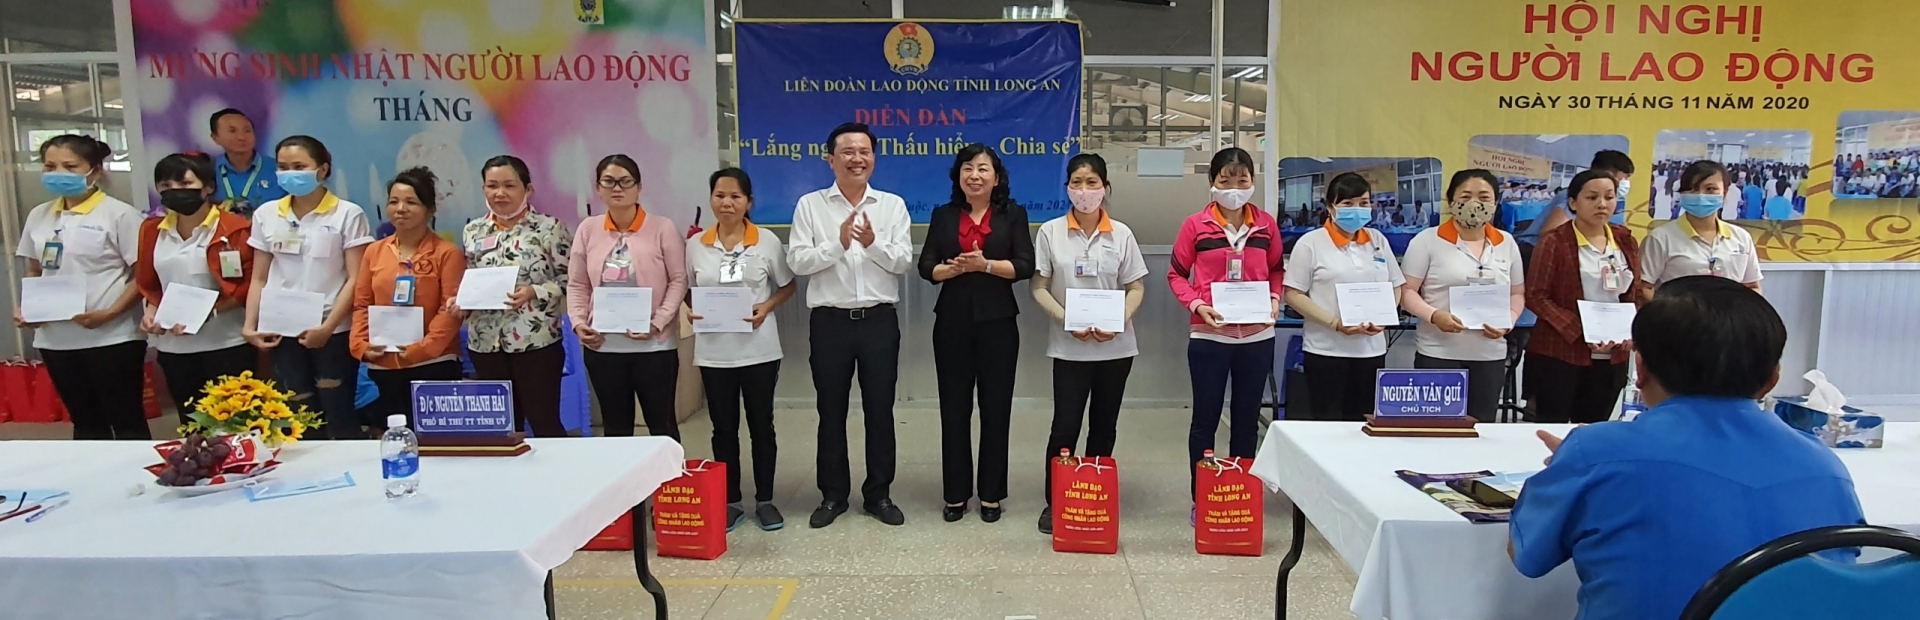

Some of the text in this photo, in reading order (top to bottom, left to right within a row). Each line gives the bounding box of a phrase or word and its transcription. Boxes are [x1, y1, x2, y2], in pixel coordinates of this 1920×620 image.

[1524, 0, 1762, 42] HỘI NGHỊ
[250, 53, 322, 79] SINH
[331, 48, 414, 87] NHẬT
[423, 45, 524, 81] NGƯỜI
[532, 54, 595, 82] LAO
[603, 51, 691, 89] ĐỘNG
[1411, 43, 1874, 89] NGƯỜI LAO ĐỘNG
[785, 76, 819, 92] LIÊN
[824, 76, 866, 92] ĐOÀN
[871, 80, 902, 92] LAO
[906, 78, 949, 94] ĐỘNG
[995, 79, 1037, 91] LONG
[1040, 79, 1061, 91] AN
[373, 90, 472, 122] THÁNG
[1499, 92, 1810, 109] NGÀY 30 THÁNG 11 NĂM 2020
[918, 104, 967, 126] ĐÀN
[876, 132, 929, 156] Thấu
[1000, 136, 1046, 155] Chia
[465, 395, 491, 411] THANH
[1422, 382, 1442, 402] VĂN
[1443, 381, 1462, 405] QUÍ
[1401, 404, 1441, 413] CHỦ TỊCH
